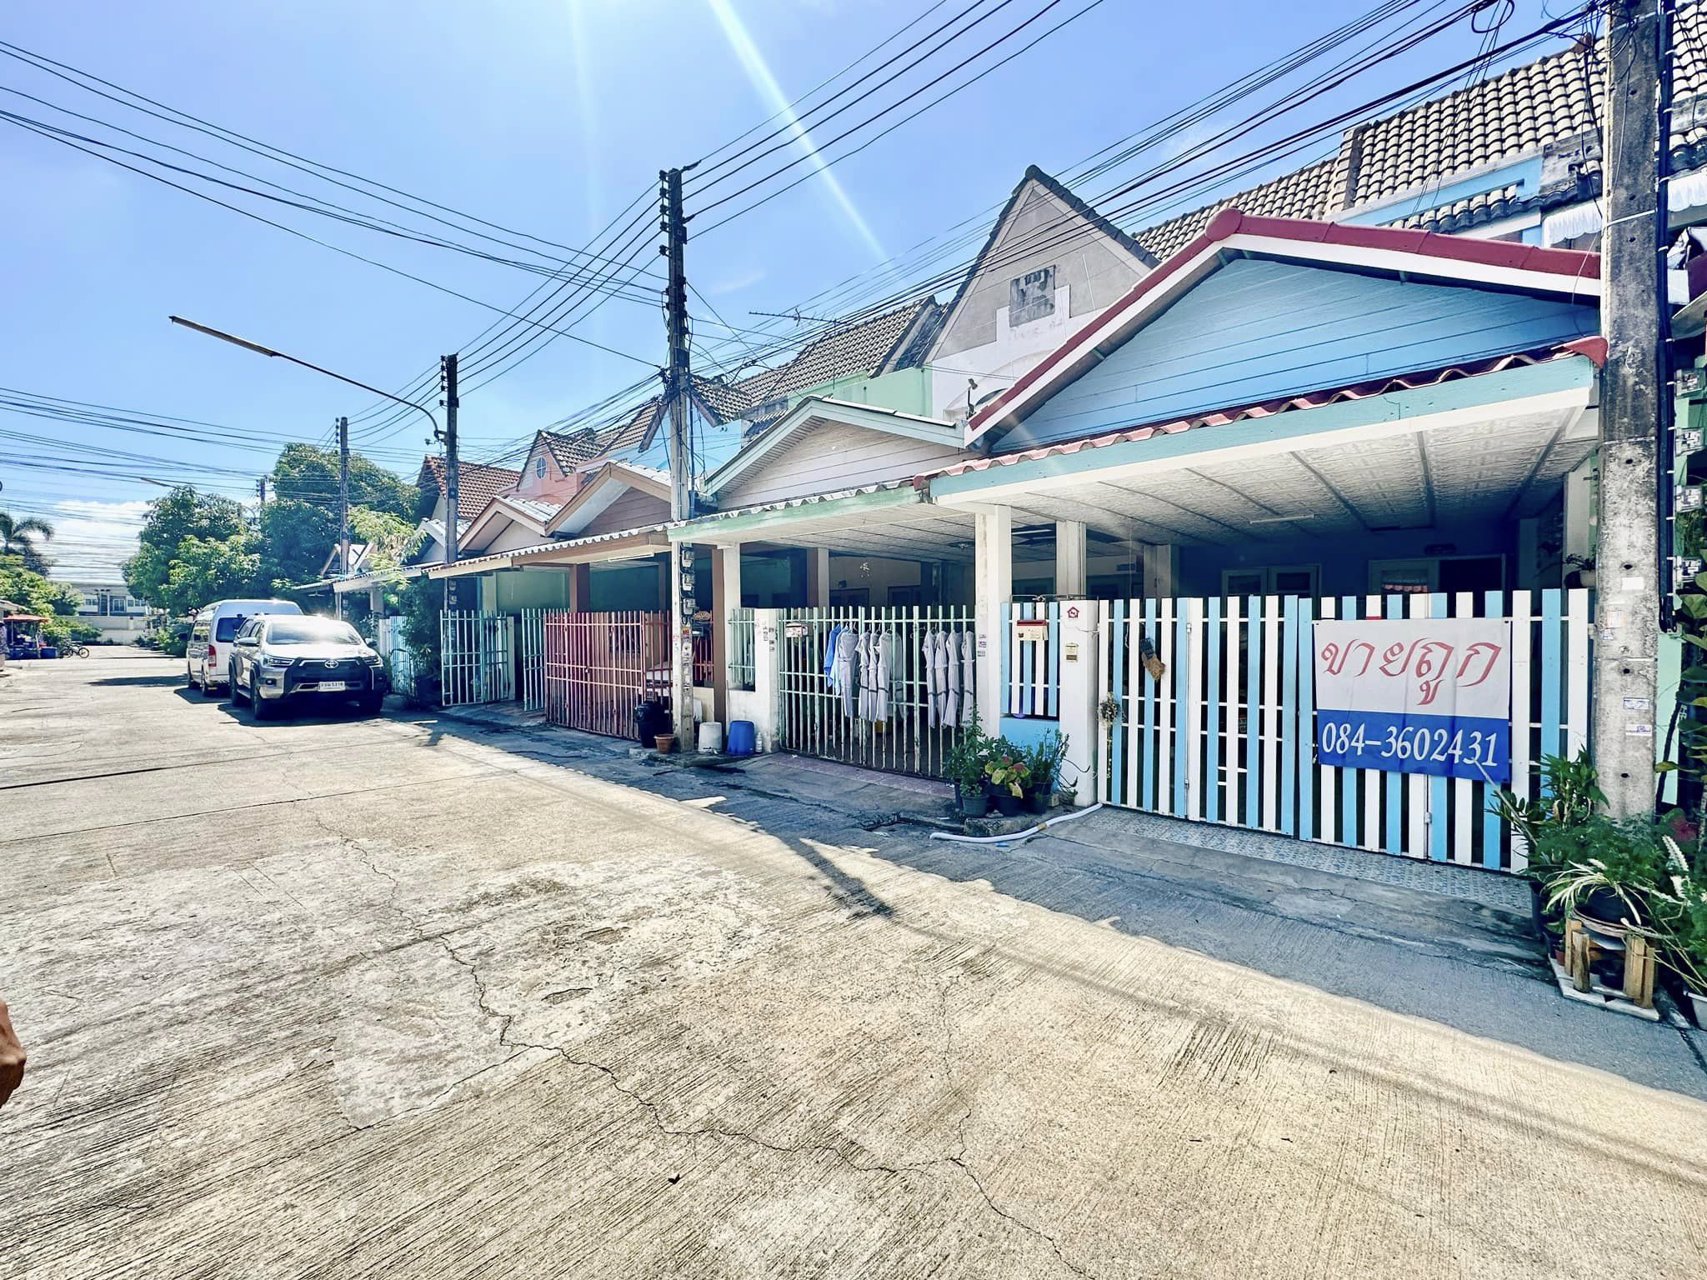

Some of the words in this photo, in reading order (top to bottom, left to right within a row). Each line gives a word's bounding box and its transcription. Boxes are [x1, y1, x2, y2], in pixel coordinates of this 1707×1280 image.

[1320, 637, 1503, 706] ขายถูก
[1321, 722, 1498, 767] 084-3602431
